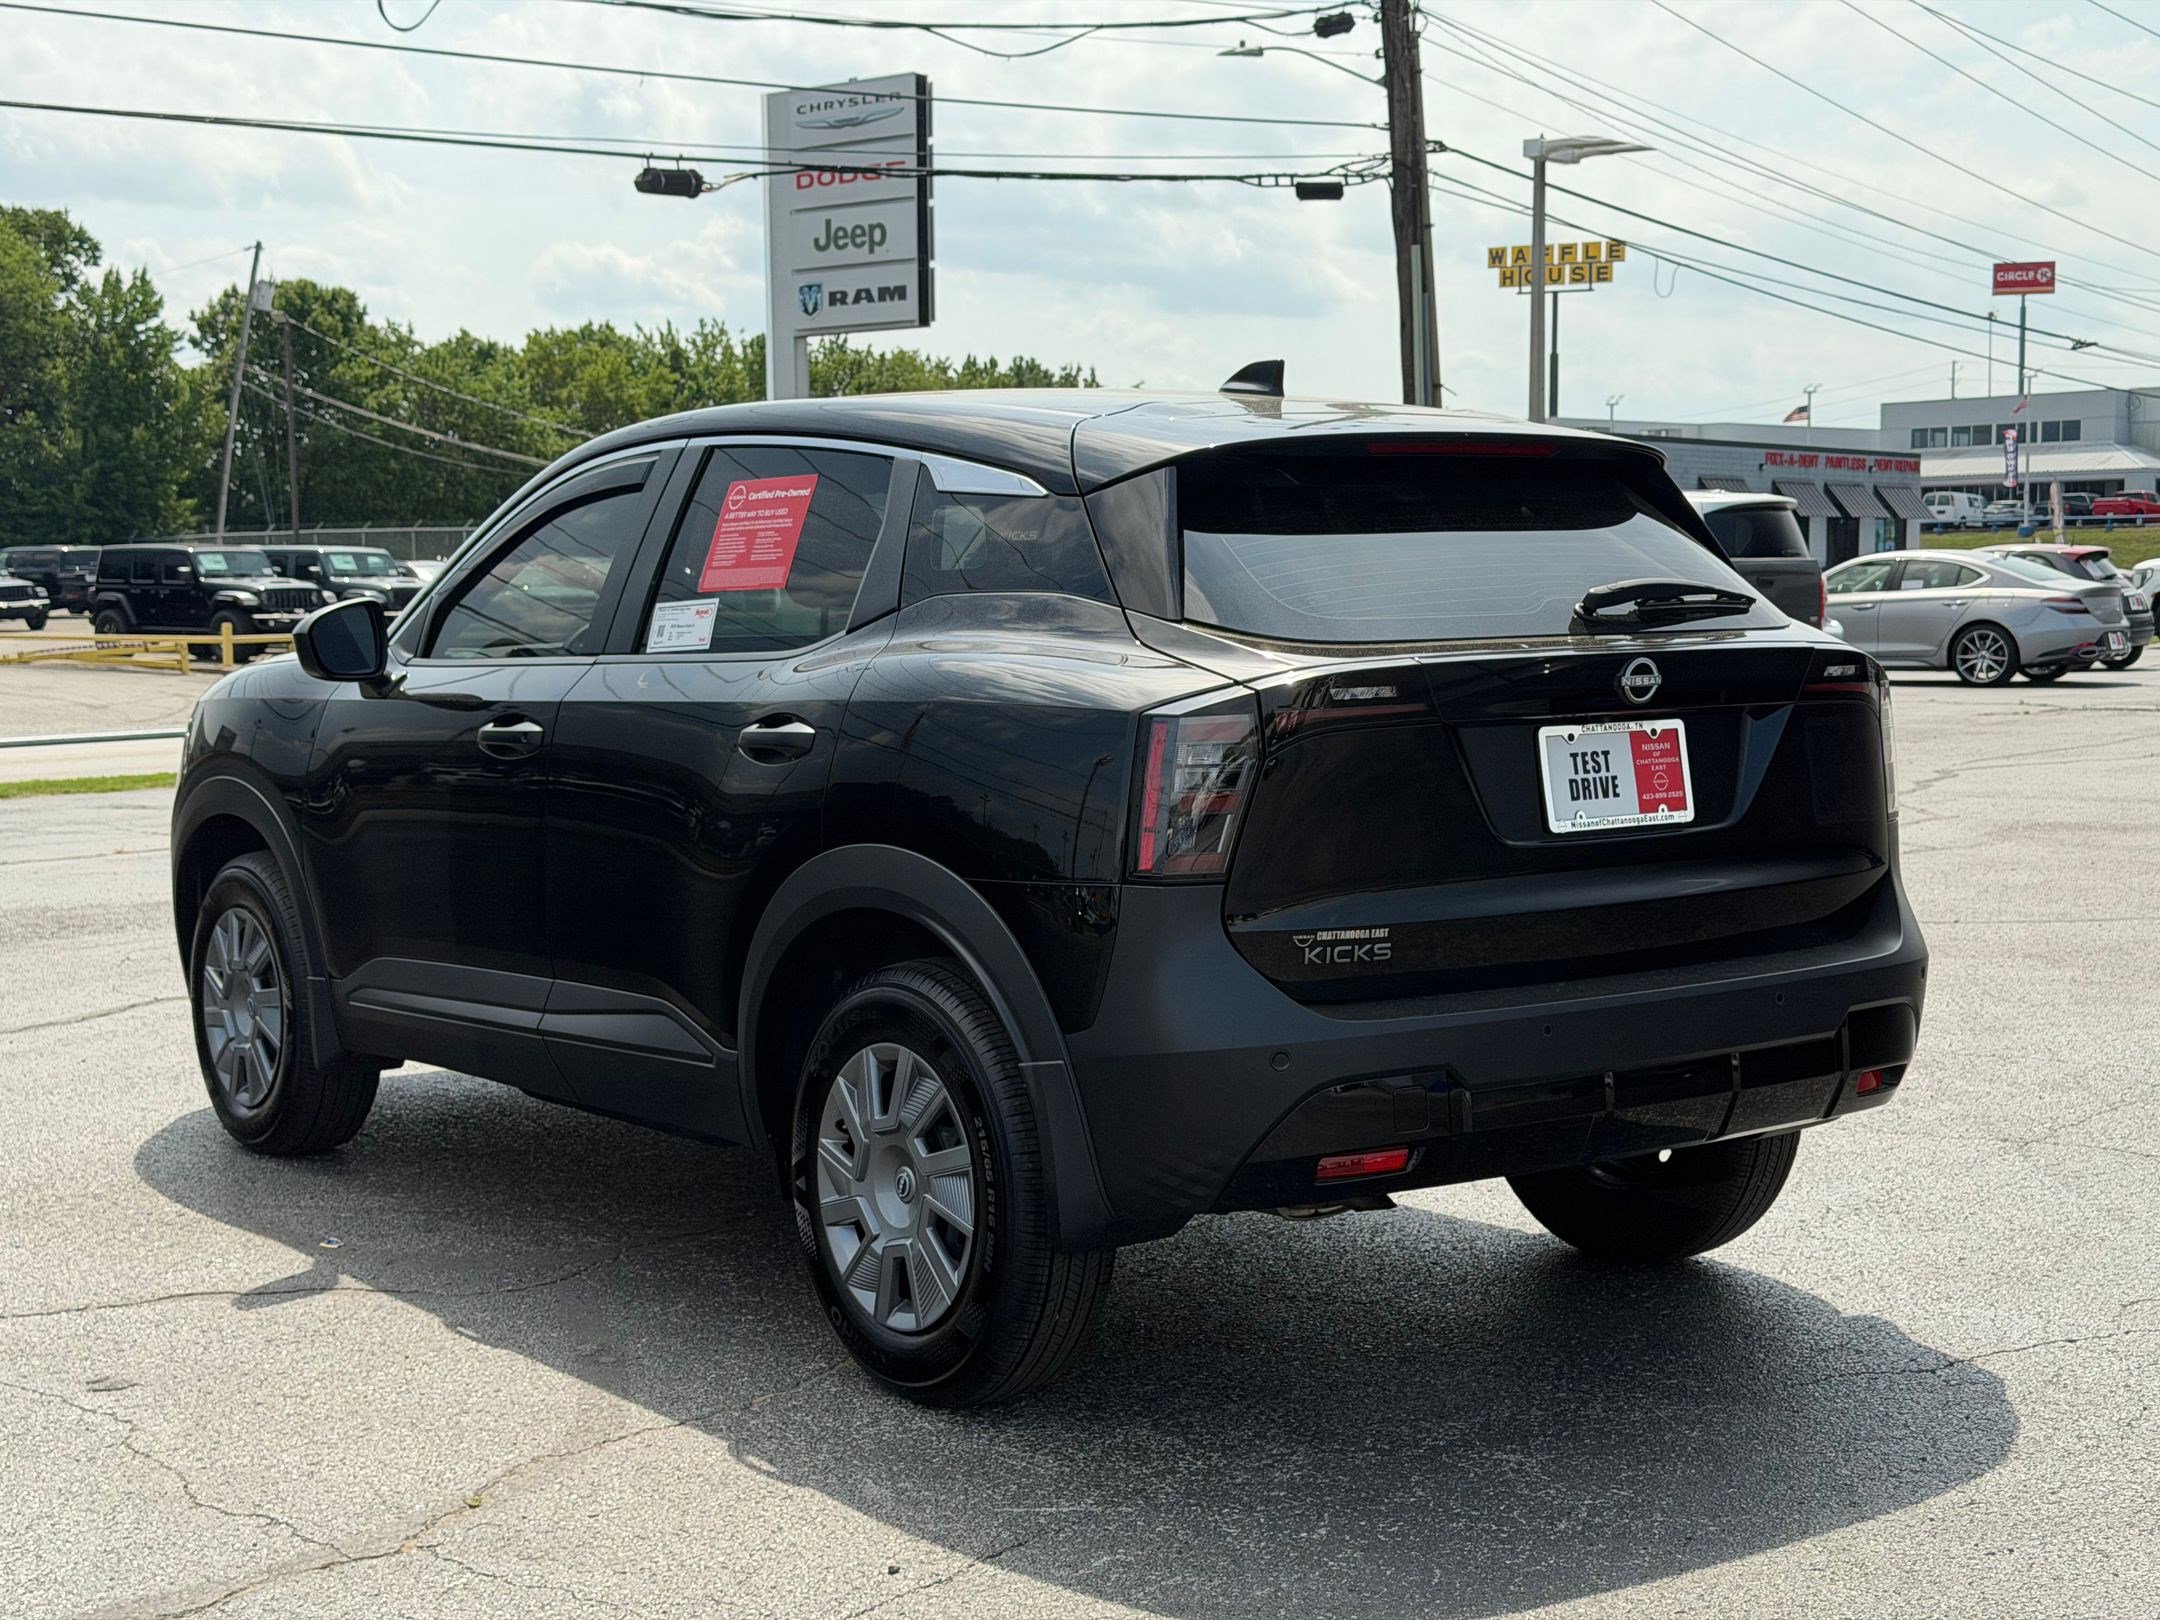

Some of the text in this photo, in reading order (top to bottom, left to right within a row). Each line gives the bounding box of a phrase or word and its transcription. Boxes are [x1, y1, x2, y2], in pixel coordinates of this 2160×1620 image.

[796, 92, 902, 115] CHRYSLER
[813, 218, 887, 254] Jeep
[1997, 271, 2036, 281] CIRCLE
[828, 285, 907, 307] RAM
[1826, 455, 1867, 471] PAINTLESS
[749, 490, 775, 500] Certified
[775, 488, 811, 498] Pre-Owned
[1622, 676, 1661, 686] NISSAN
[1635, 722, 1644, 730] TN
[1641, 742, 1671, 751] NISSAN
[1569, 750, 1611, 775] TEST
[1635, 756, 1680, 766] CHATTANOOGA
[1568, 775, 1621, 802] DRIVE
[1570, 814, 1675, 829] NissanofChattanoogaEast.com
[1317, 930, 1370, 940] CHATTANOOGA
[1371, 928, 1390, 938] EAST
[1304, 943, 1392, 965] KICKS
